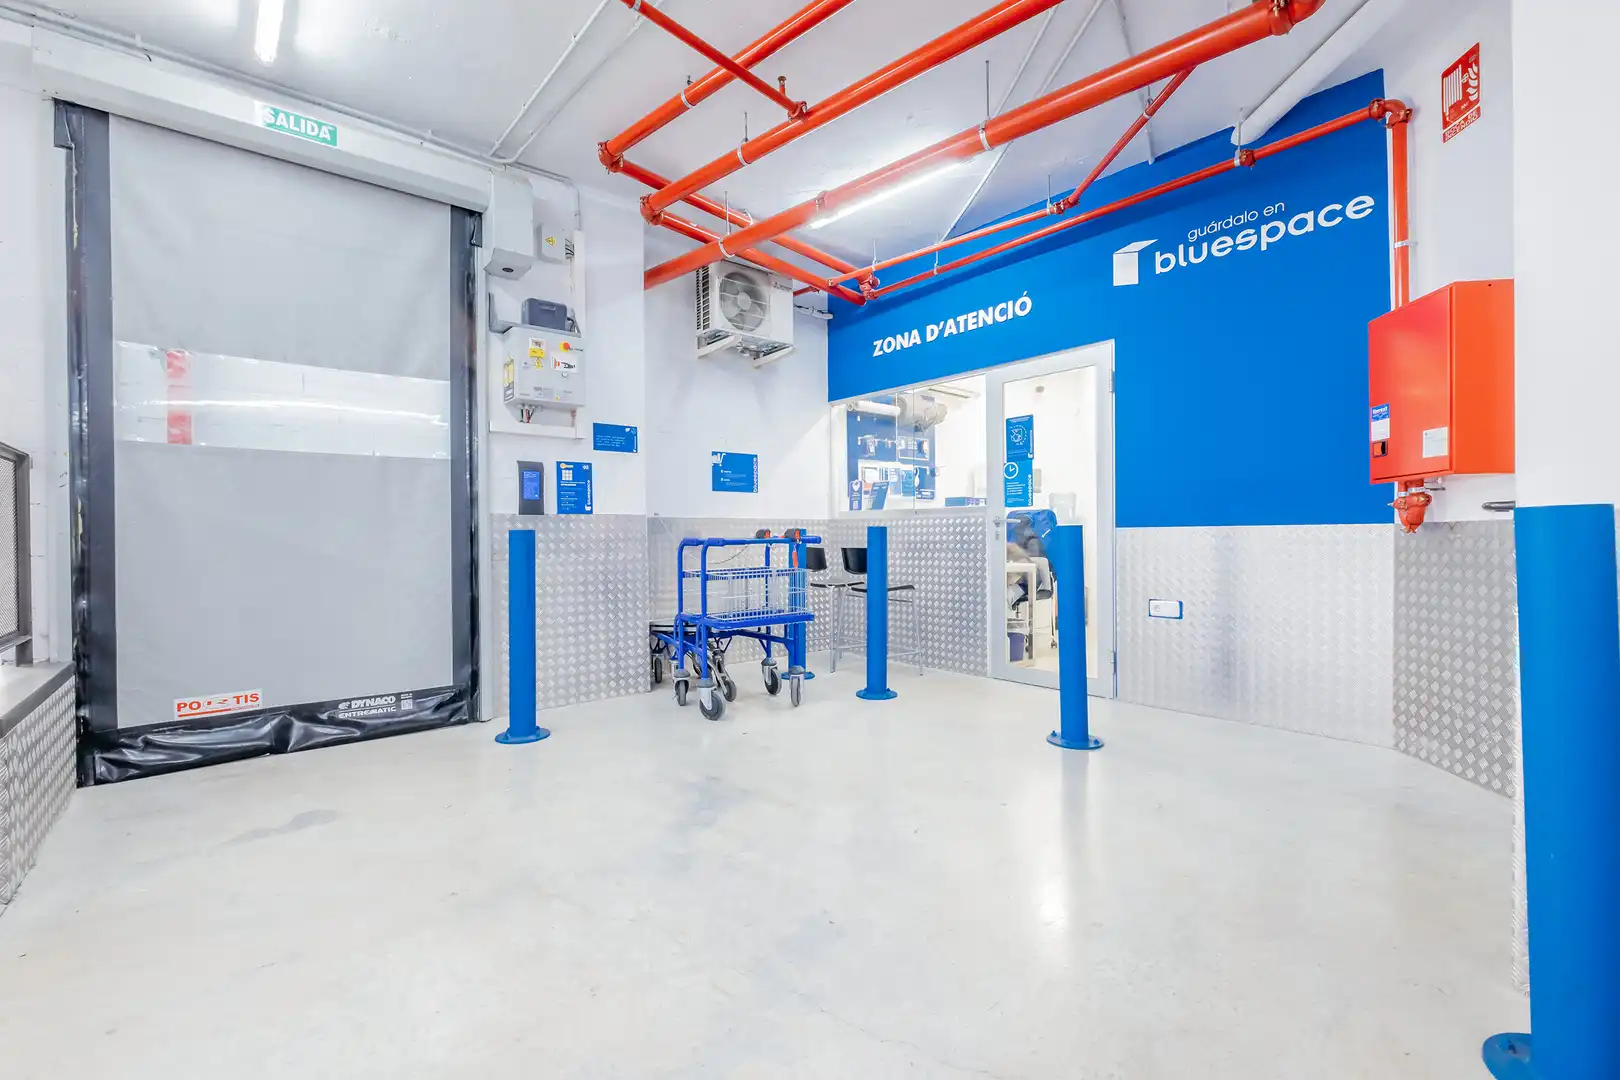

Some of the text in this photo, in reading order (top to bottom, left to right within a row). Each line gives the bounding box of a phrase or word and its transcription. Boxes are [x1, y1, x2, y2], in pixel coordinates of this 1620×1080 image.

[264, 108, 331, 141] SALIDA
[1155, 195, 1375, 275] bluespace
[1187, 201, 1285, 242] guárdalo en
[872, 328, 922, 357] ZONA
[339, 706, 397, 719] ENTREMATIC
[351, 695, 396, 709] DYNACO
